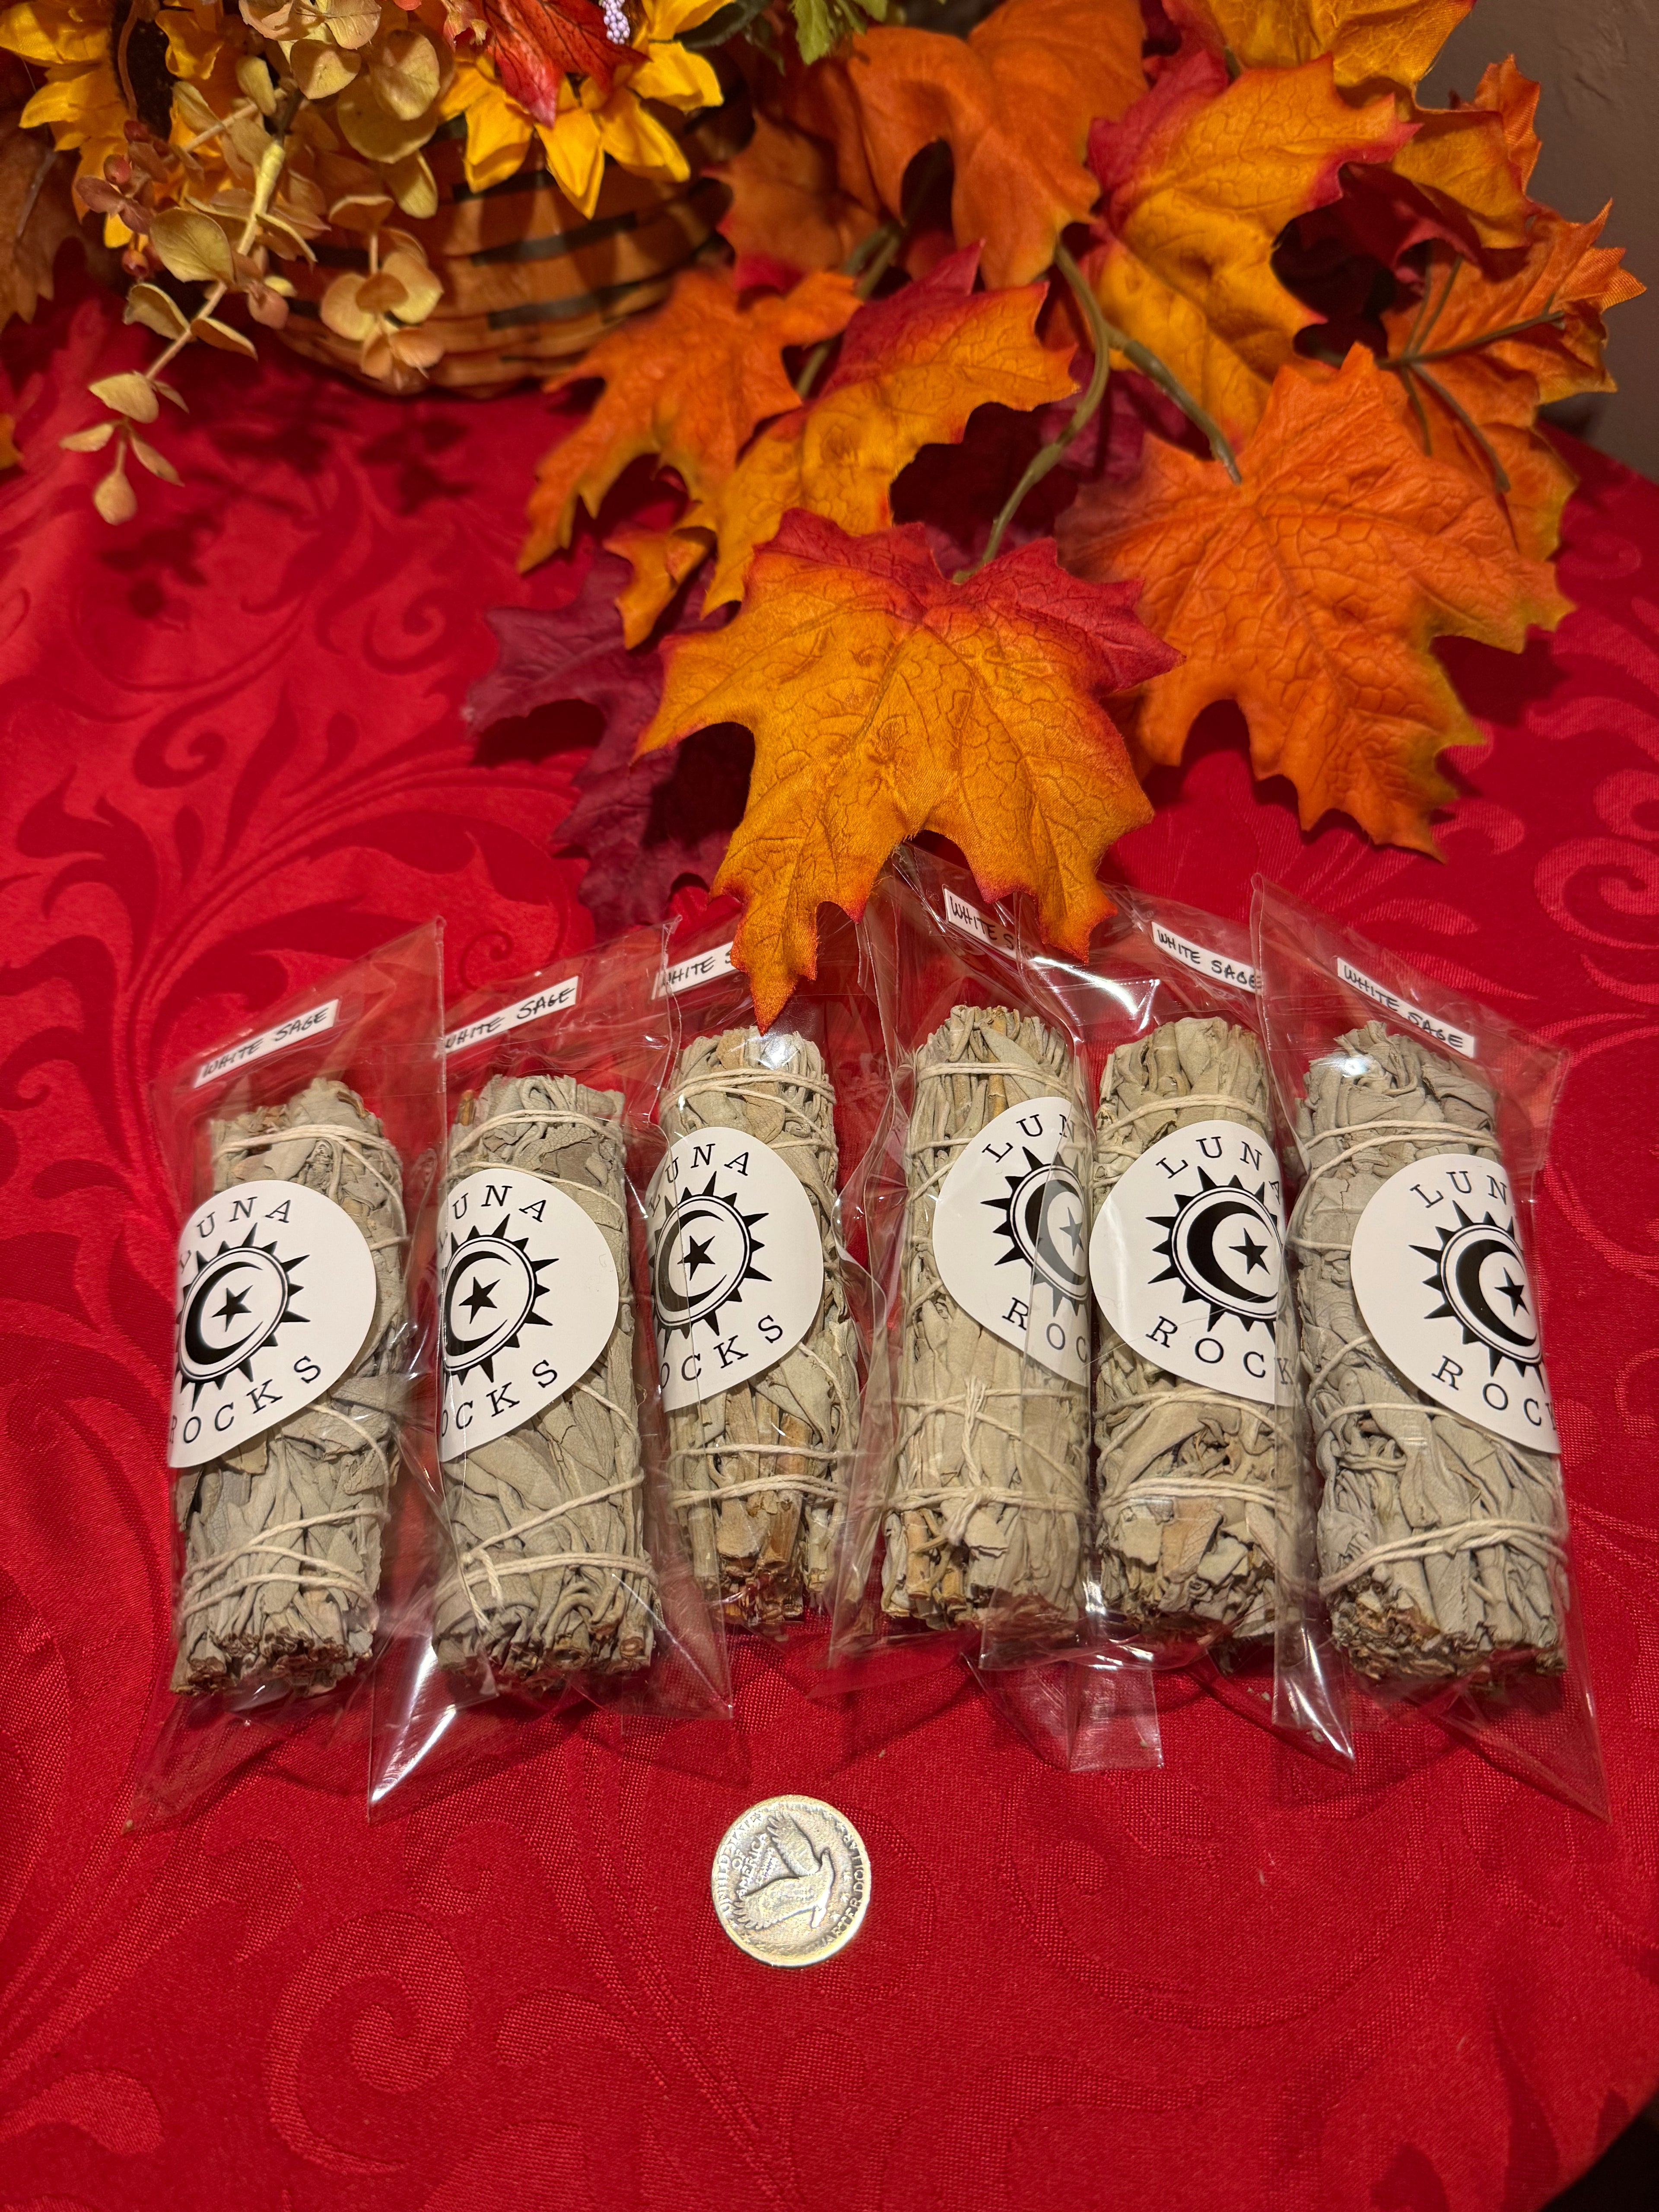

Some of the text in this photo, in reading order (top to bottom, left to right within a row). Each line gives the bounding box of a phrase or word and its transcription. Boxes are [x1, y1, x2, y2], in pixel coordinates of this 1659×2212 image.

[950, 896, 998, 941] WHITE
[1157, 929, 1201, 964] WHITE
[517, 987, 575, 1020] SAGE
[1344, 965, 1463, 1048] WHITE SAGE
[202, 1007, 329, 1078] WHITE SAGE
[982, 1113, 1077, 1163] LUN
[1155, 1136, 1281, 1205] LUNA
[1409, 1171, 1508, 1209] LUN
[660, 1315, 783, 1389] OCKS
[1002, 1296, 1087, 1363] ROC
[1145, 1316, 1294, 1385] ROCK
[442, 1359, 558, 1437] OCKS
[732, 1848, 746, 1869] OF
